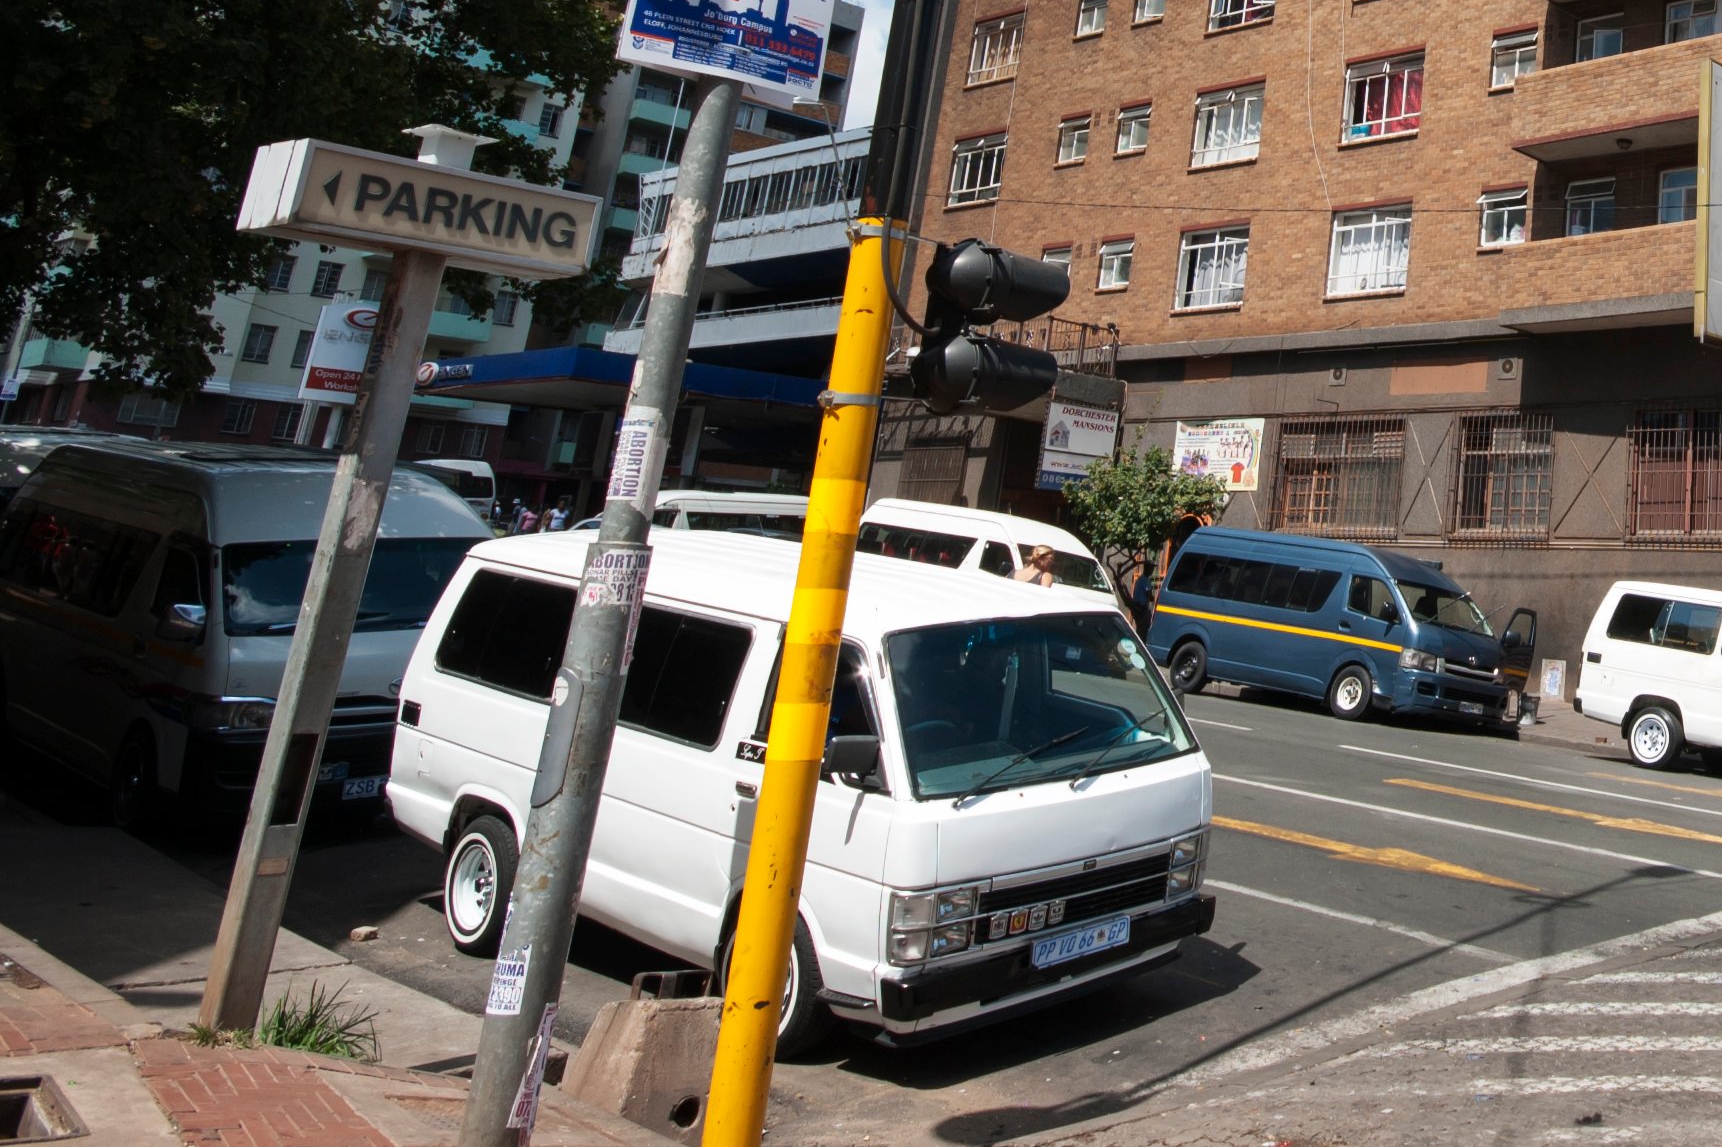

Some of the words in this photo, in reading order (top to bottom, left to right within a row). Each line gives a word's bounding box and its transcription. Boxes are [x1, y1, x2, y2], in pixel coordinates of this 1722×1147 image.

[674, 15, 699, 27] STREET
[740, 16, 773, 34] Campus
[354, 173, 577, 249] PARKING
[324, 329, 371, 344] ENG
[315, 369, 341, 379] Open
[324, 382, 361, 391] Worksh
[1062, 406, 1116, 422] DORCHESTER
[1072, 420, 1114, 433] MANSIONS
[621, 430, 648, 498] ABORTION
[345, 779, 375, 796] ZSB
[1107, 921, 1126, 941] GP
